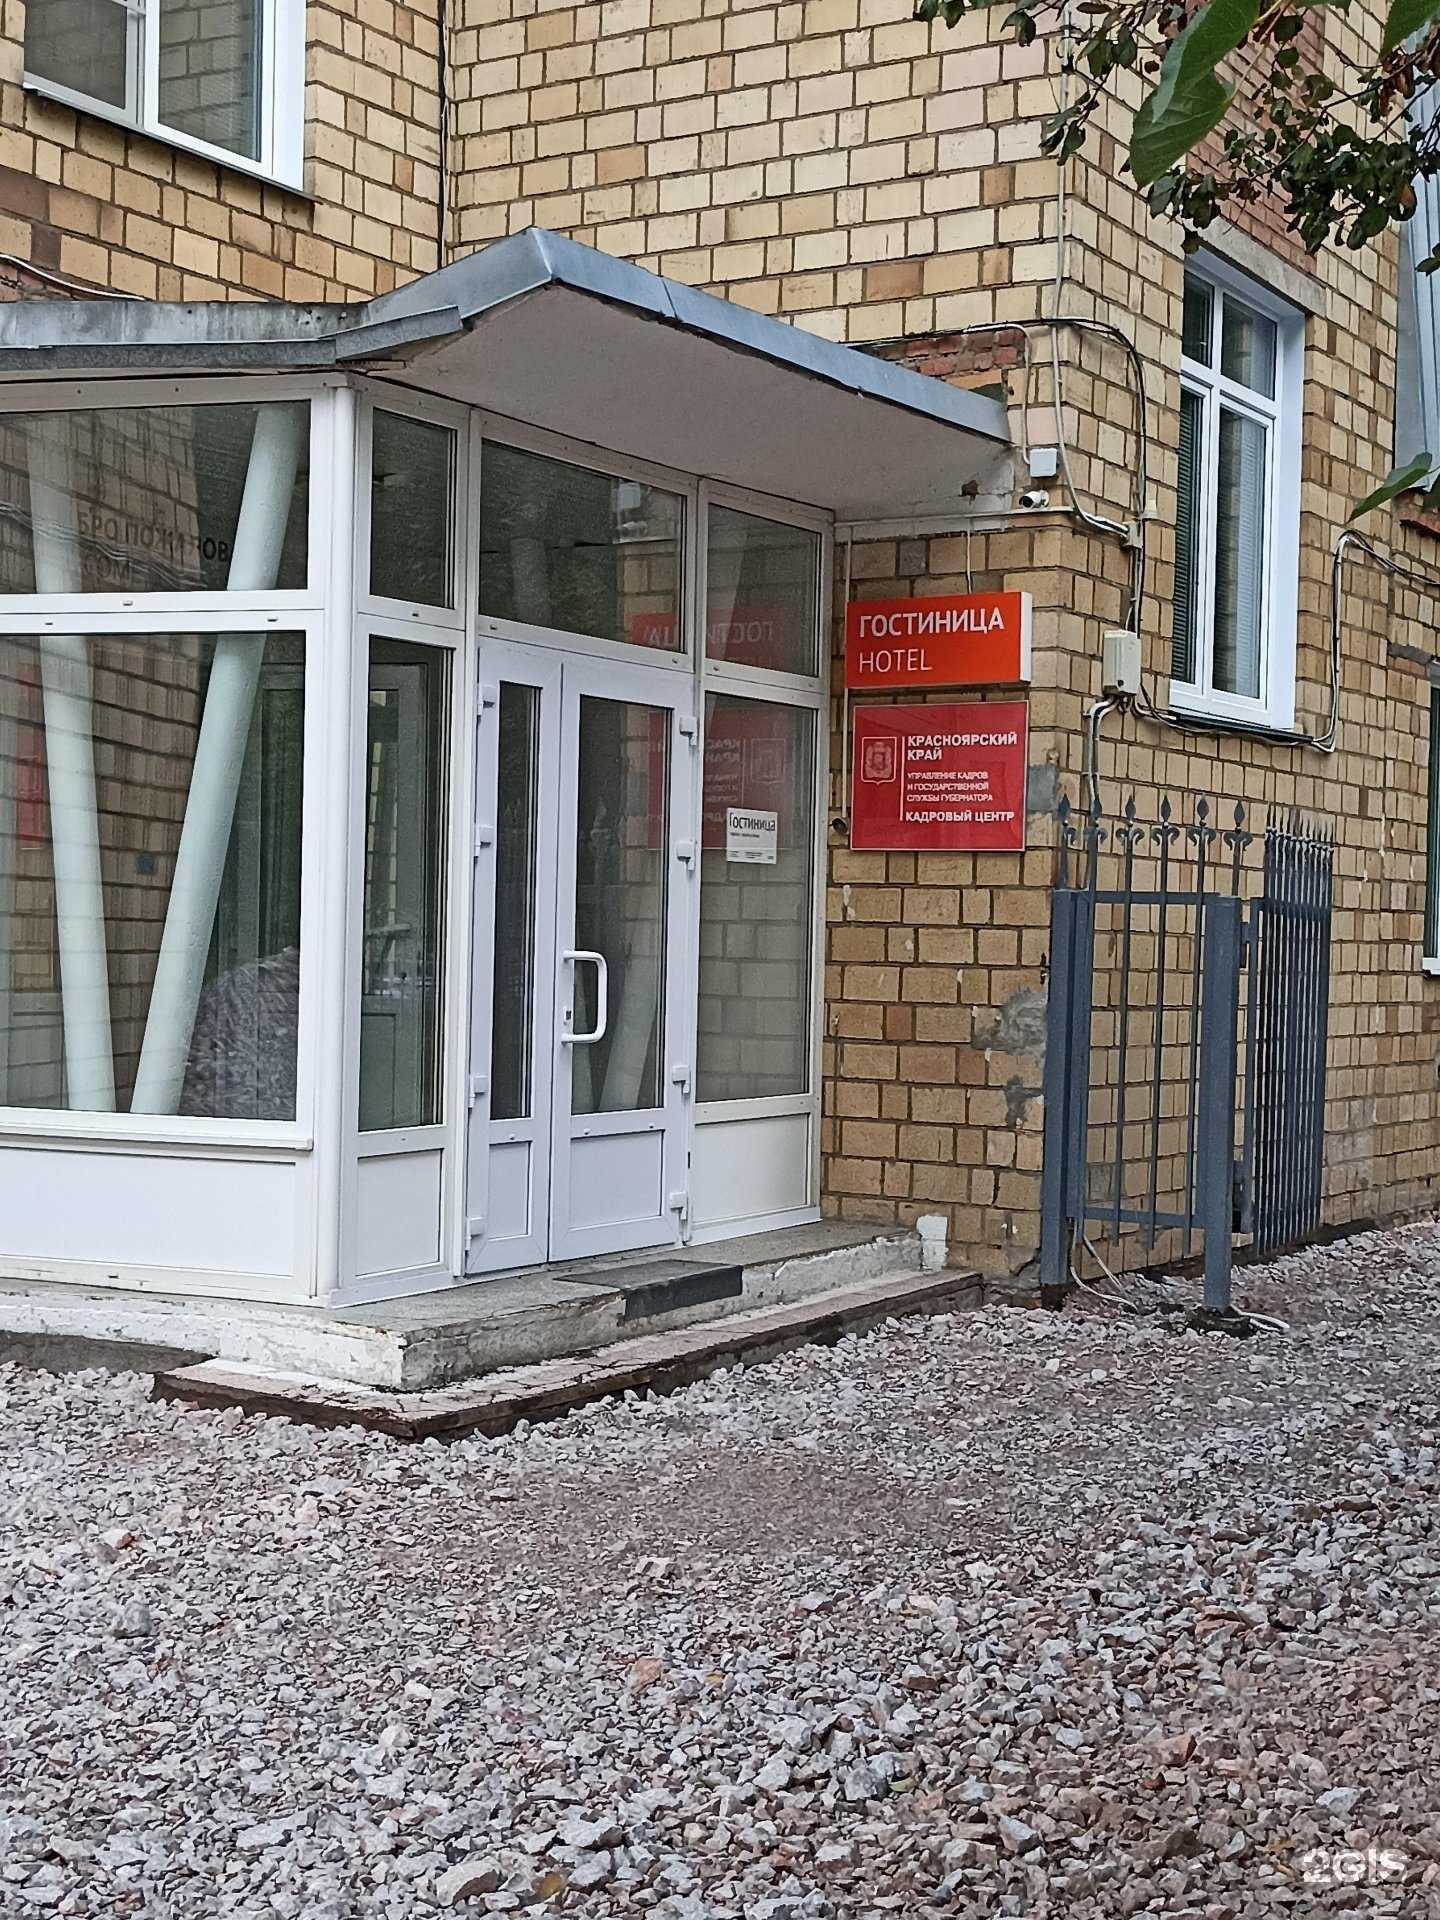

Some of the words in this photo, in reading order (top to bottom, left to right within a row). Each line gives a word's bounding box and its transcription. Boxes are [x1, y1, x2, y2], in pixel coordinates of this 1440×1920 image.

[859, 606, 1005, 638] ГОСТИНИЦА
[859, 648, 933, 673] HOTEL
[907, 731, 1018, 747] КРАСНОЯРСКИЙ
[907, 747, 943, 761] КРАЙ
[907, 772, 956, 780] УПРАВЛЕНИЕ
[957, 771, 989, 781] КАДРОВ
[907, 783, 913, 791] И
[914, 781, 989, 792] ГОСУДАРСТВЕННОЙ
[906, 794, 940, 802] СЛУЖБЫ
[941, 793, 994, 802] ГУБЕРНАТОРА
[729, 811, 776, 832] Гостиница
[905, 809, 972, 823] КАДРОВЫЙ
[974, 810, 1015, 823] ЦЕНТР
